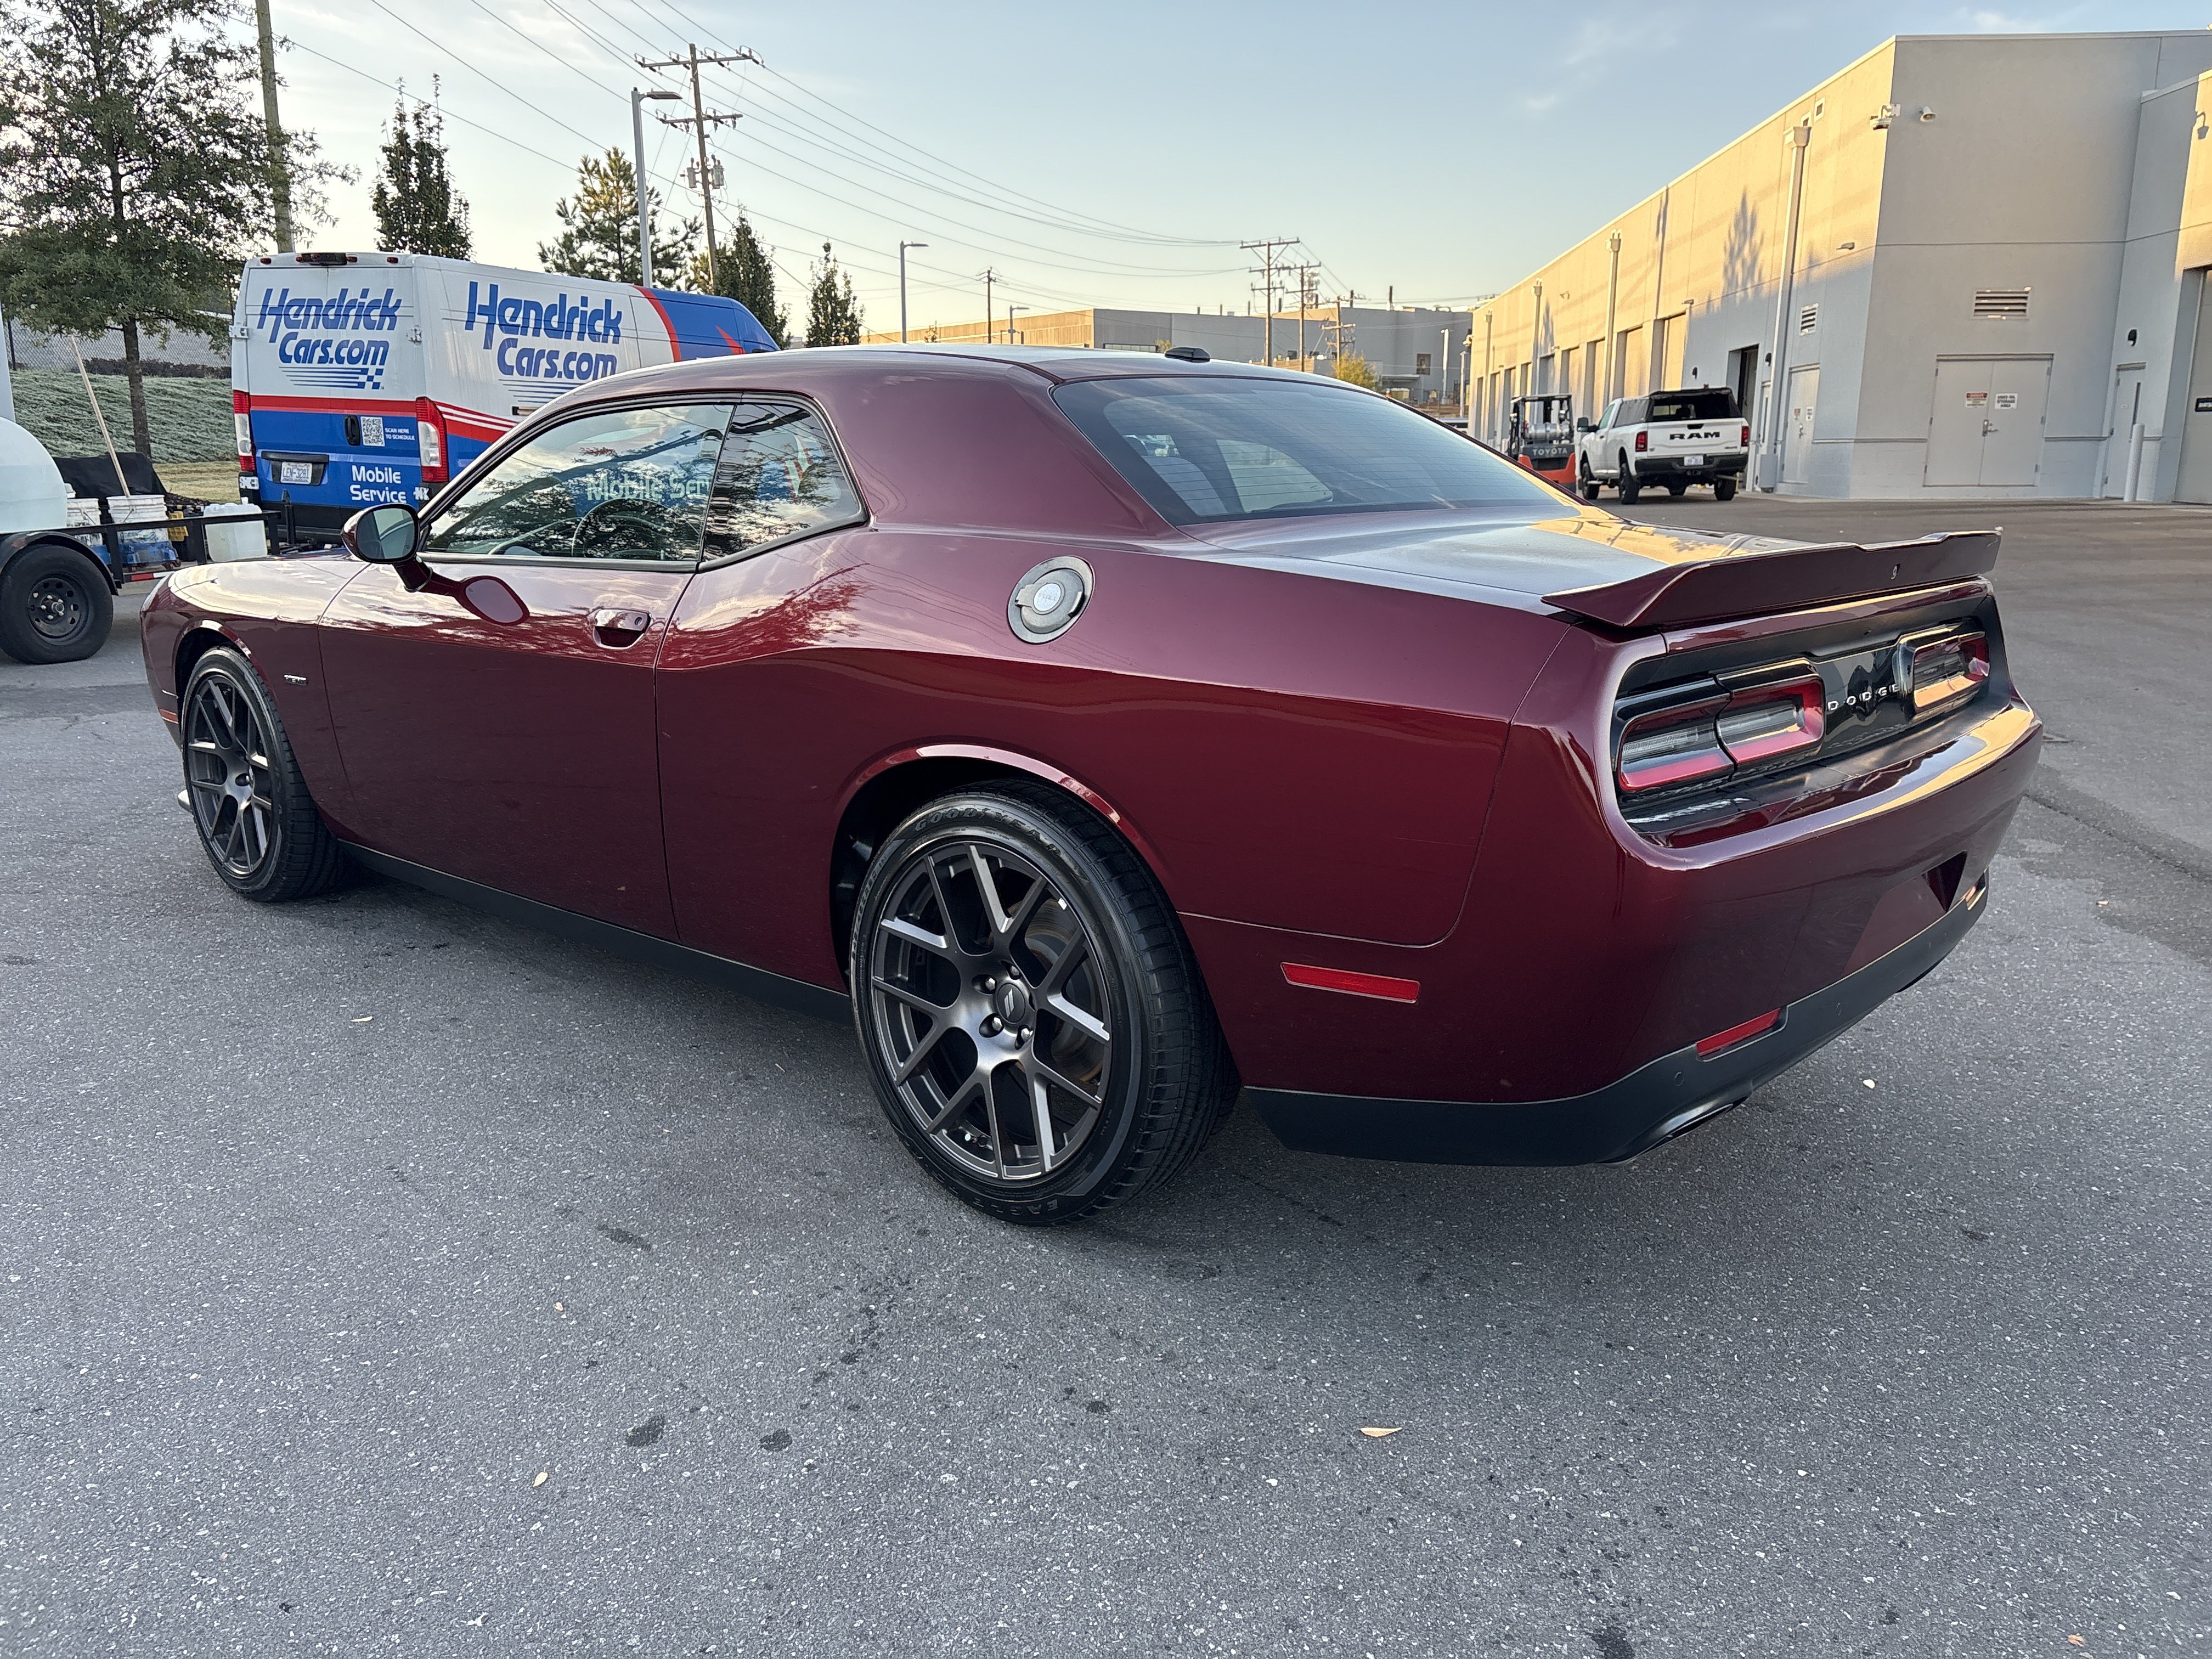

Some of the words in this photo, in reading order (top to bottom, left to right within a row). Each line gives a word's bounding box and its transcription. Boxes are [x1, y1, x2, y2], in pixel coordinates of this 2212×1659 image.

[257, 288, 402, 343] Hendrick
[465, 281, 623, 349] Hendrick
[278, 331, 390, 365] Cars.com
[497, 337, 617, 380] Cars.com
[1669, 432, 1720, 440] RAM
[1532, 447, 1568, 456] TOYOTA
[352, 465, 402, 484] Mobile
[349, 484, 407, 503] Service
[1827, 684, 1900, 711] DODGE
